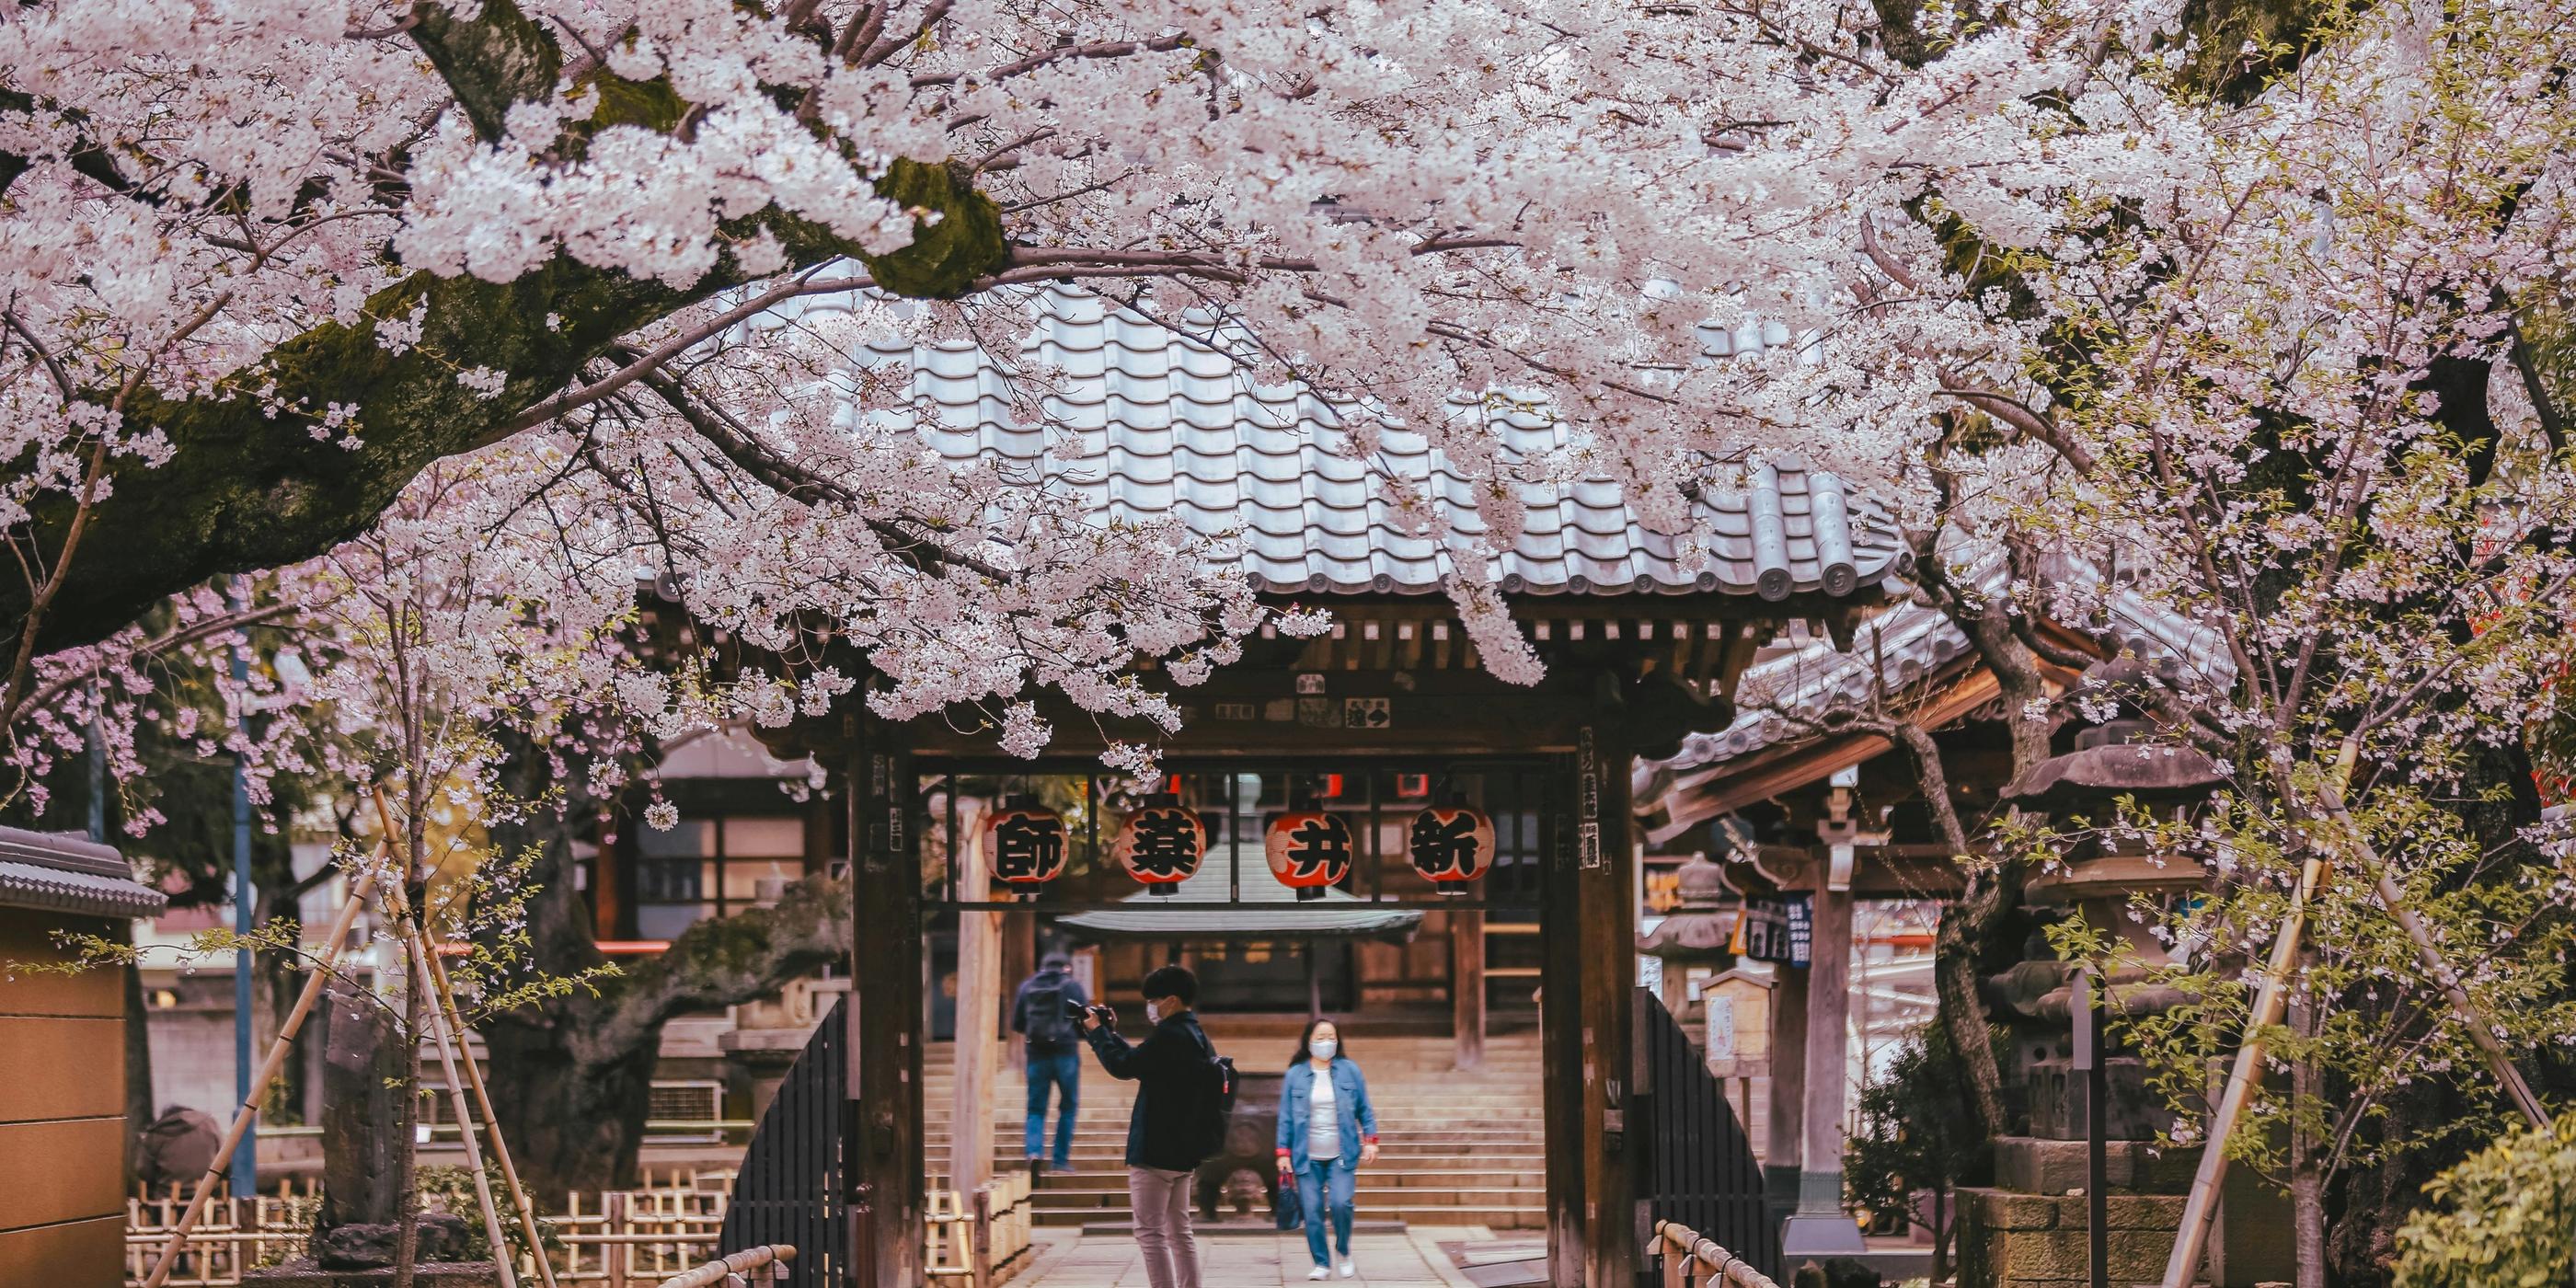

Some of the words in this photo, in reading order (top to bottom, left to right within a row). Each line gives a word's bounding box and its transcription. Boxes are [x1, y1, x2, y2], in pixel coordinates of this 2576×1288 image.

[996, 813, 1064, 878] 師
[1132, 810, 1198, 875] 薬
[1288, 813, 1351, 878] 井
[1410, 811, 1479, 875] 新
